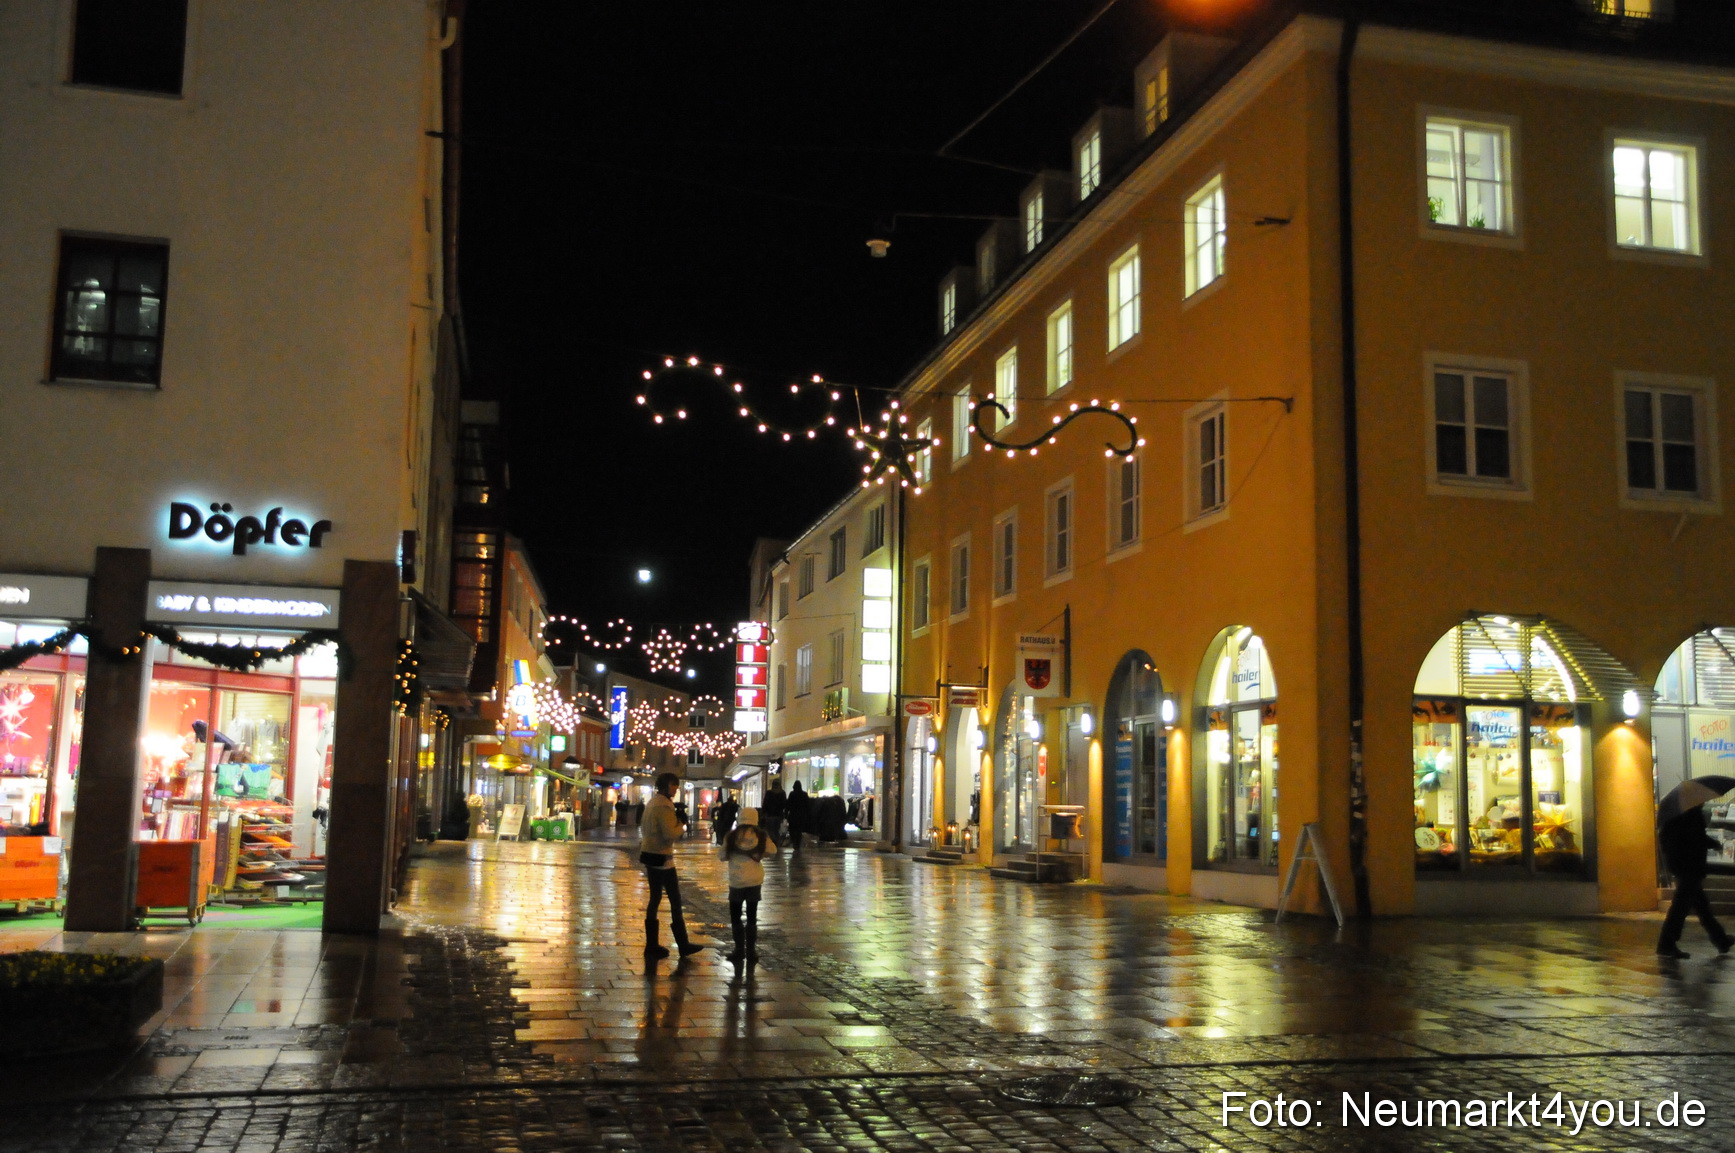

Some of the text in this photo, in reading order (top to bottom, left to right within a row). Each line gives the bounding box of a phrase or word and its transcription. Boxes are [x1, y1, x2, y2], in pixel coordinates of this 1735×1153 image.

[169, 502, 332, 555] Döpfer
[156, 595, 331, 616] BABY & KINDERMODEN
[1020, 636, 1050, 645] RATHAUS
[1232, 669, 1258, 684] hailer
[1471, 721, 1513, 733] hailer
[1699, 719, 1728, 739] FOTO
[1692, 737, 1735, 751] haile
